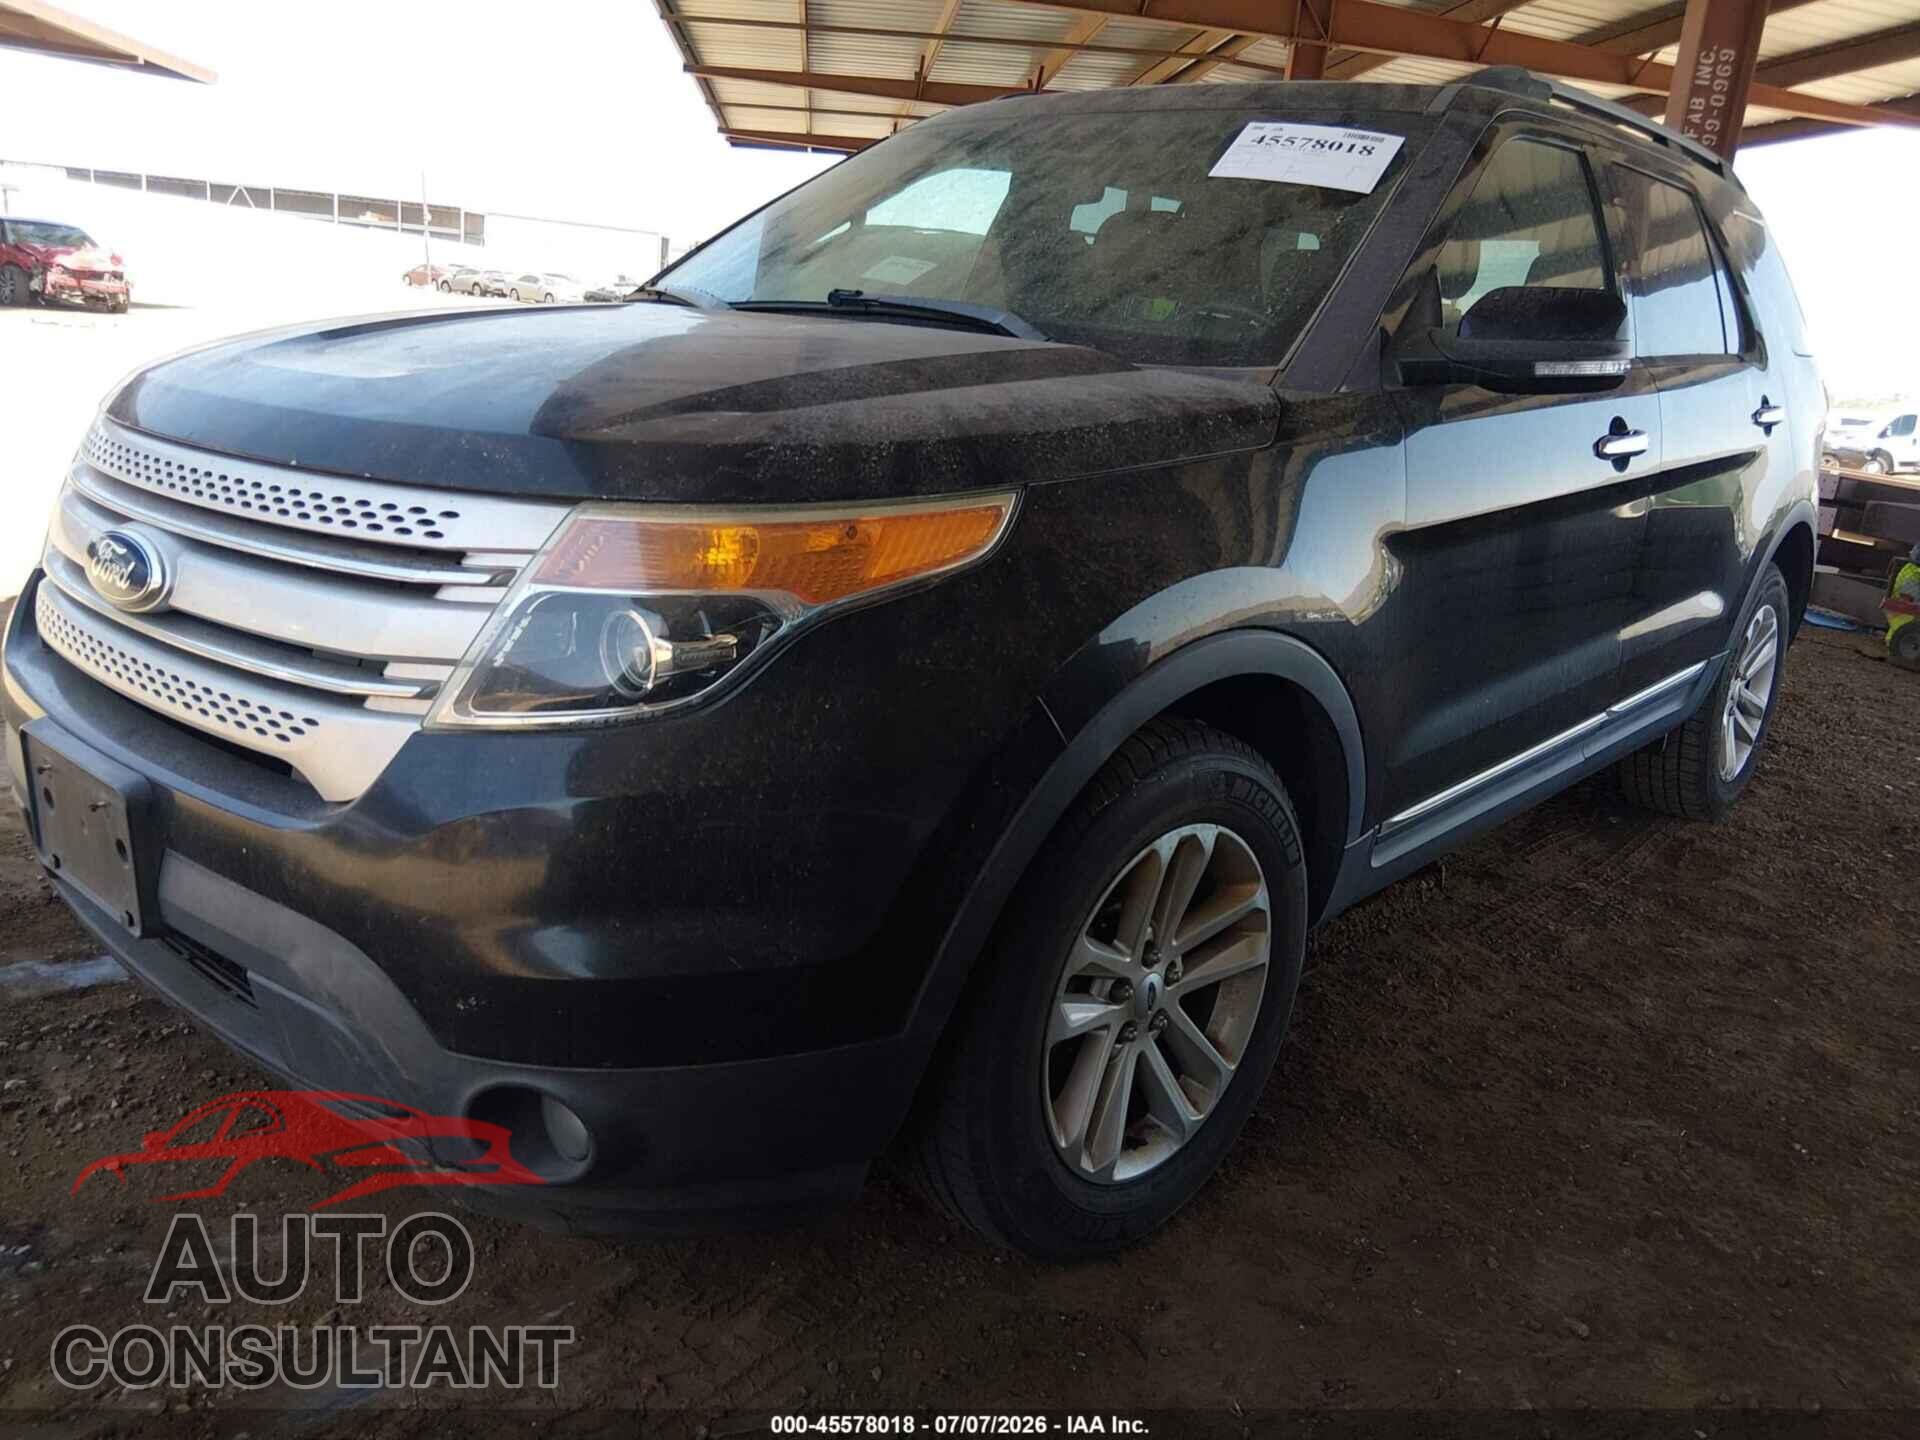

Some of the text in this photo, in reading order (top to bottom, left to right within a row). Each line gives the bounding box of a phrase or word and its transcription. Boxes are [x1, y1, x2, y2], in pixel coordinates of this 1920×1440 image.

[1684, 44, 1718, 138] FAB INC.
[1702, 48, 1735, 146] 99-0969
[1251, 134, 1376, 157] 45578018
[91, 539, 136, 590] Ford
